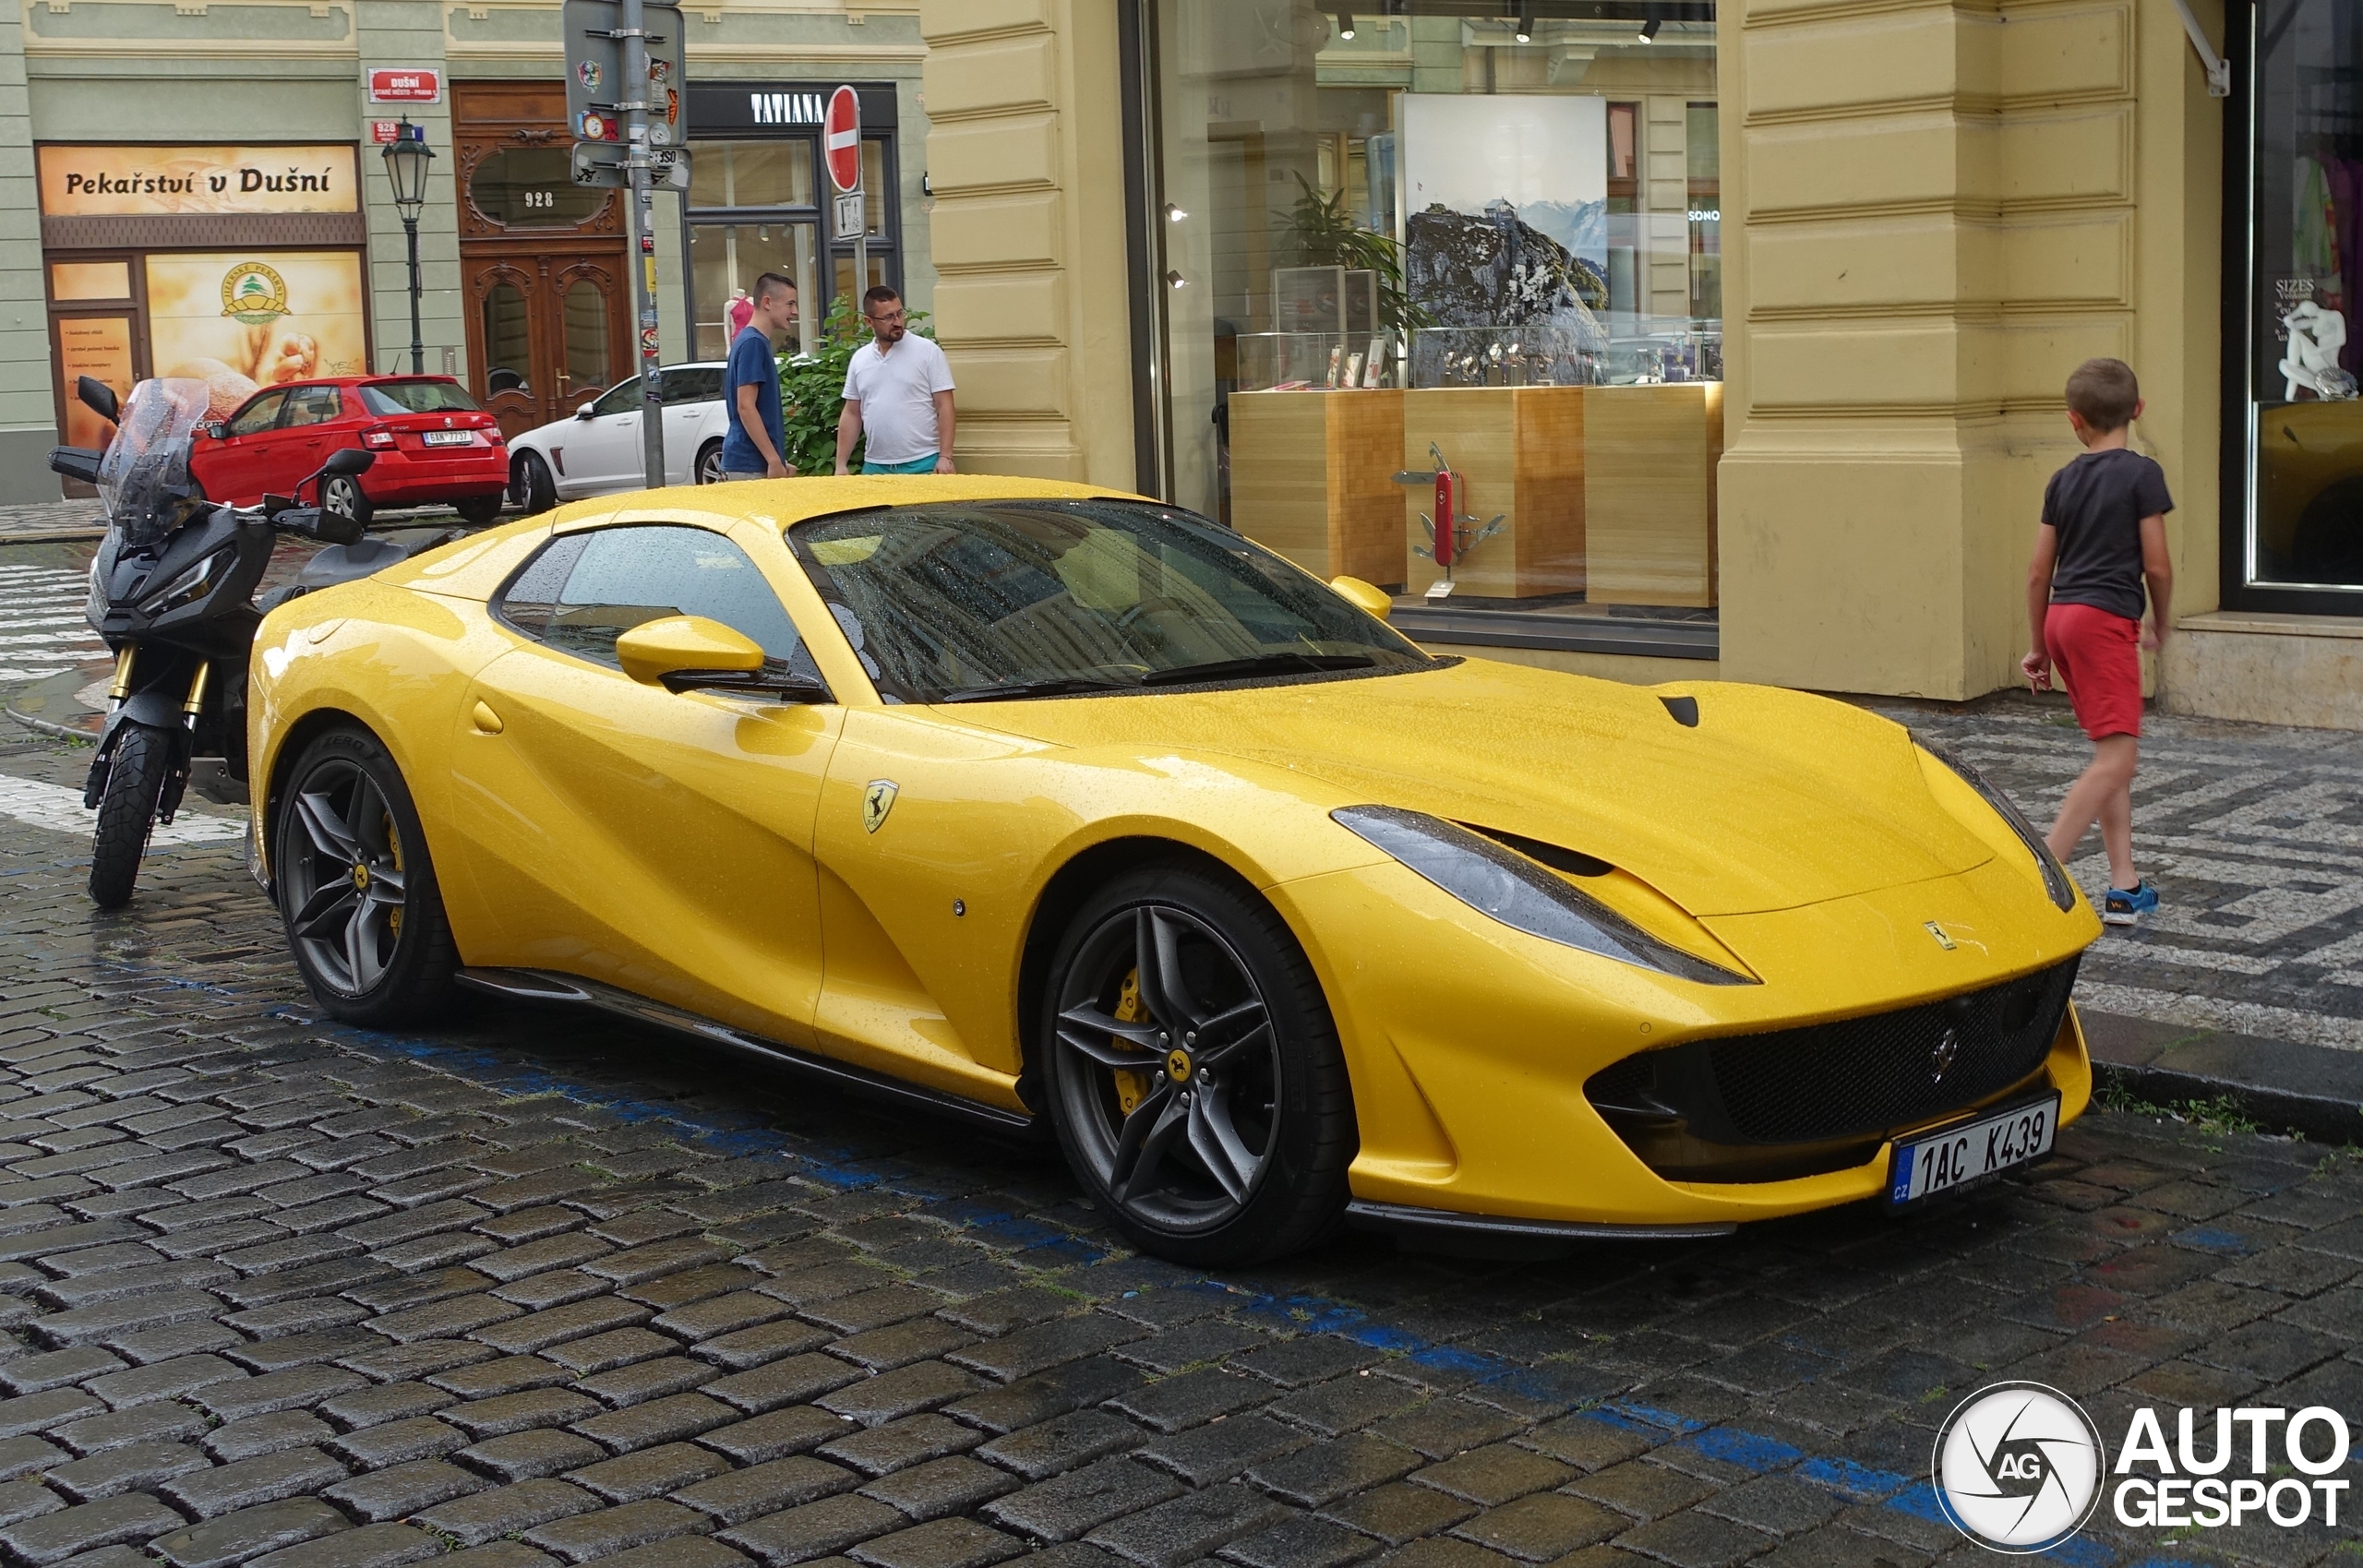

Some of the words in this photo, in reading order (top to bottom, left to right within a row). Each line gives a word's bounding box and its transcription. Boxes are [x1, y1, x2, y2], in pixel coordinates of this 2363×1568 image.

[390, 76, 420, 88] DUŠNÍ
[750, 93, 824, 123] TATIANA
[377, 123, 397, 133] 928
[66, 172, 196, 195] Pekařství
[209, 174, 228, 193] v
[239, 166, 333, 193] Dušní
[524, 191, 554, 208] 928
[2275, 278, 2315, 293] SIZES
[430, 431, 445, 442] 6AN
[449, 431, 468, 441] 7737
[1894, 1183, 1909, 1201] CZ
[1921, 1136, 1969, 1192] 1AC
[1984, 1109, 2045, 1172] K439
